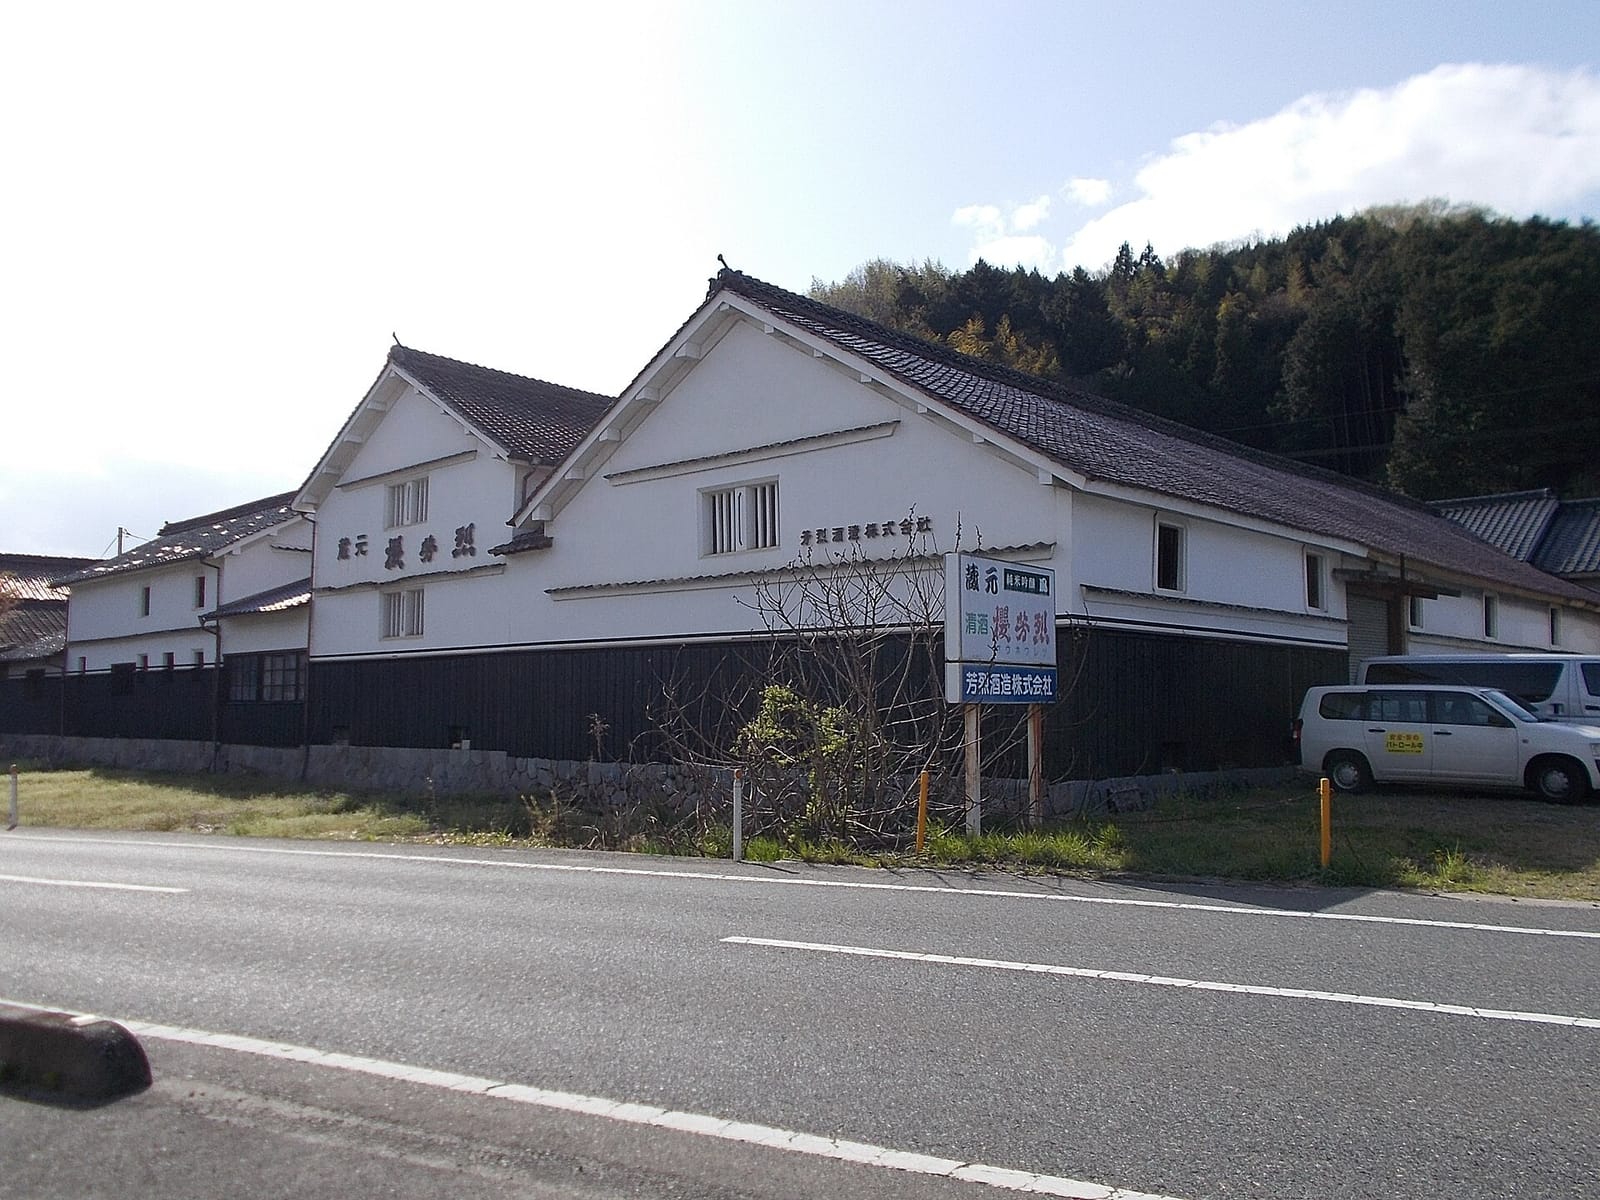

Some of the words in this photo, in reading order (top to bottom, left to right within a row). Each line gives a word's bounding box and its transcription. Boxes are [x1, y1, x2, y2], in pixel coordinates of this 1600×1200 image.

[965, 562, 999, 595] 蔵元
[965, 611, 989, 635] 清酒
[966, 671, 1053, 696] 芳烈酒造株式会社
